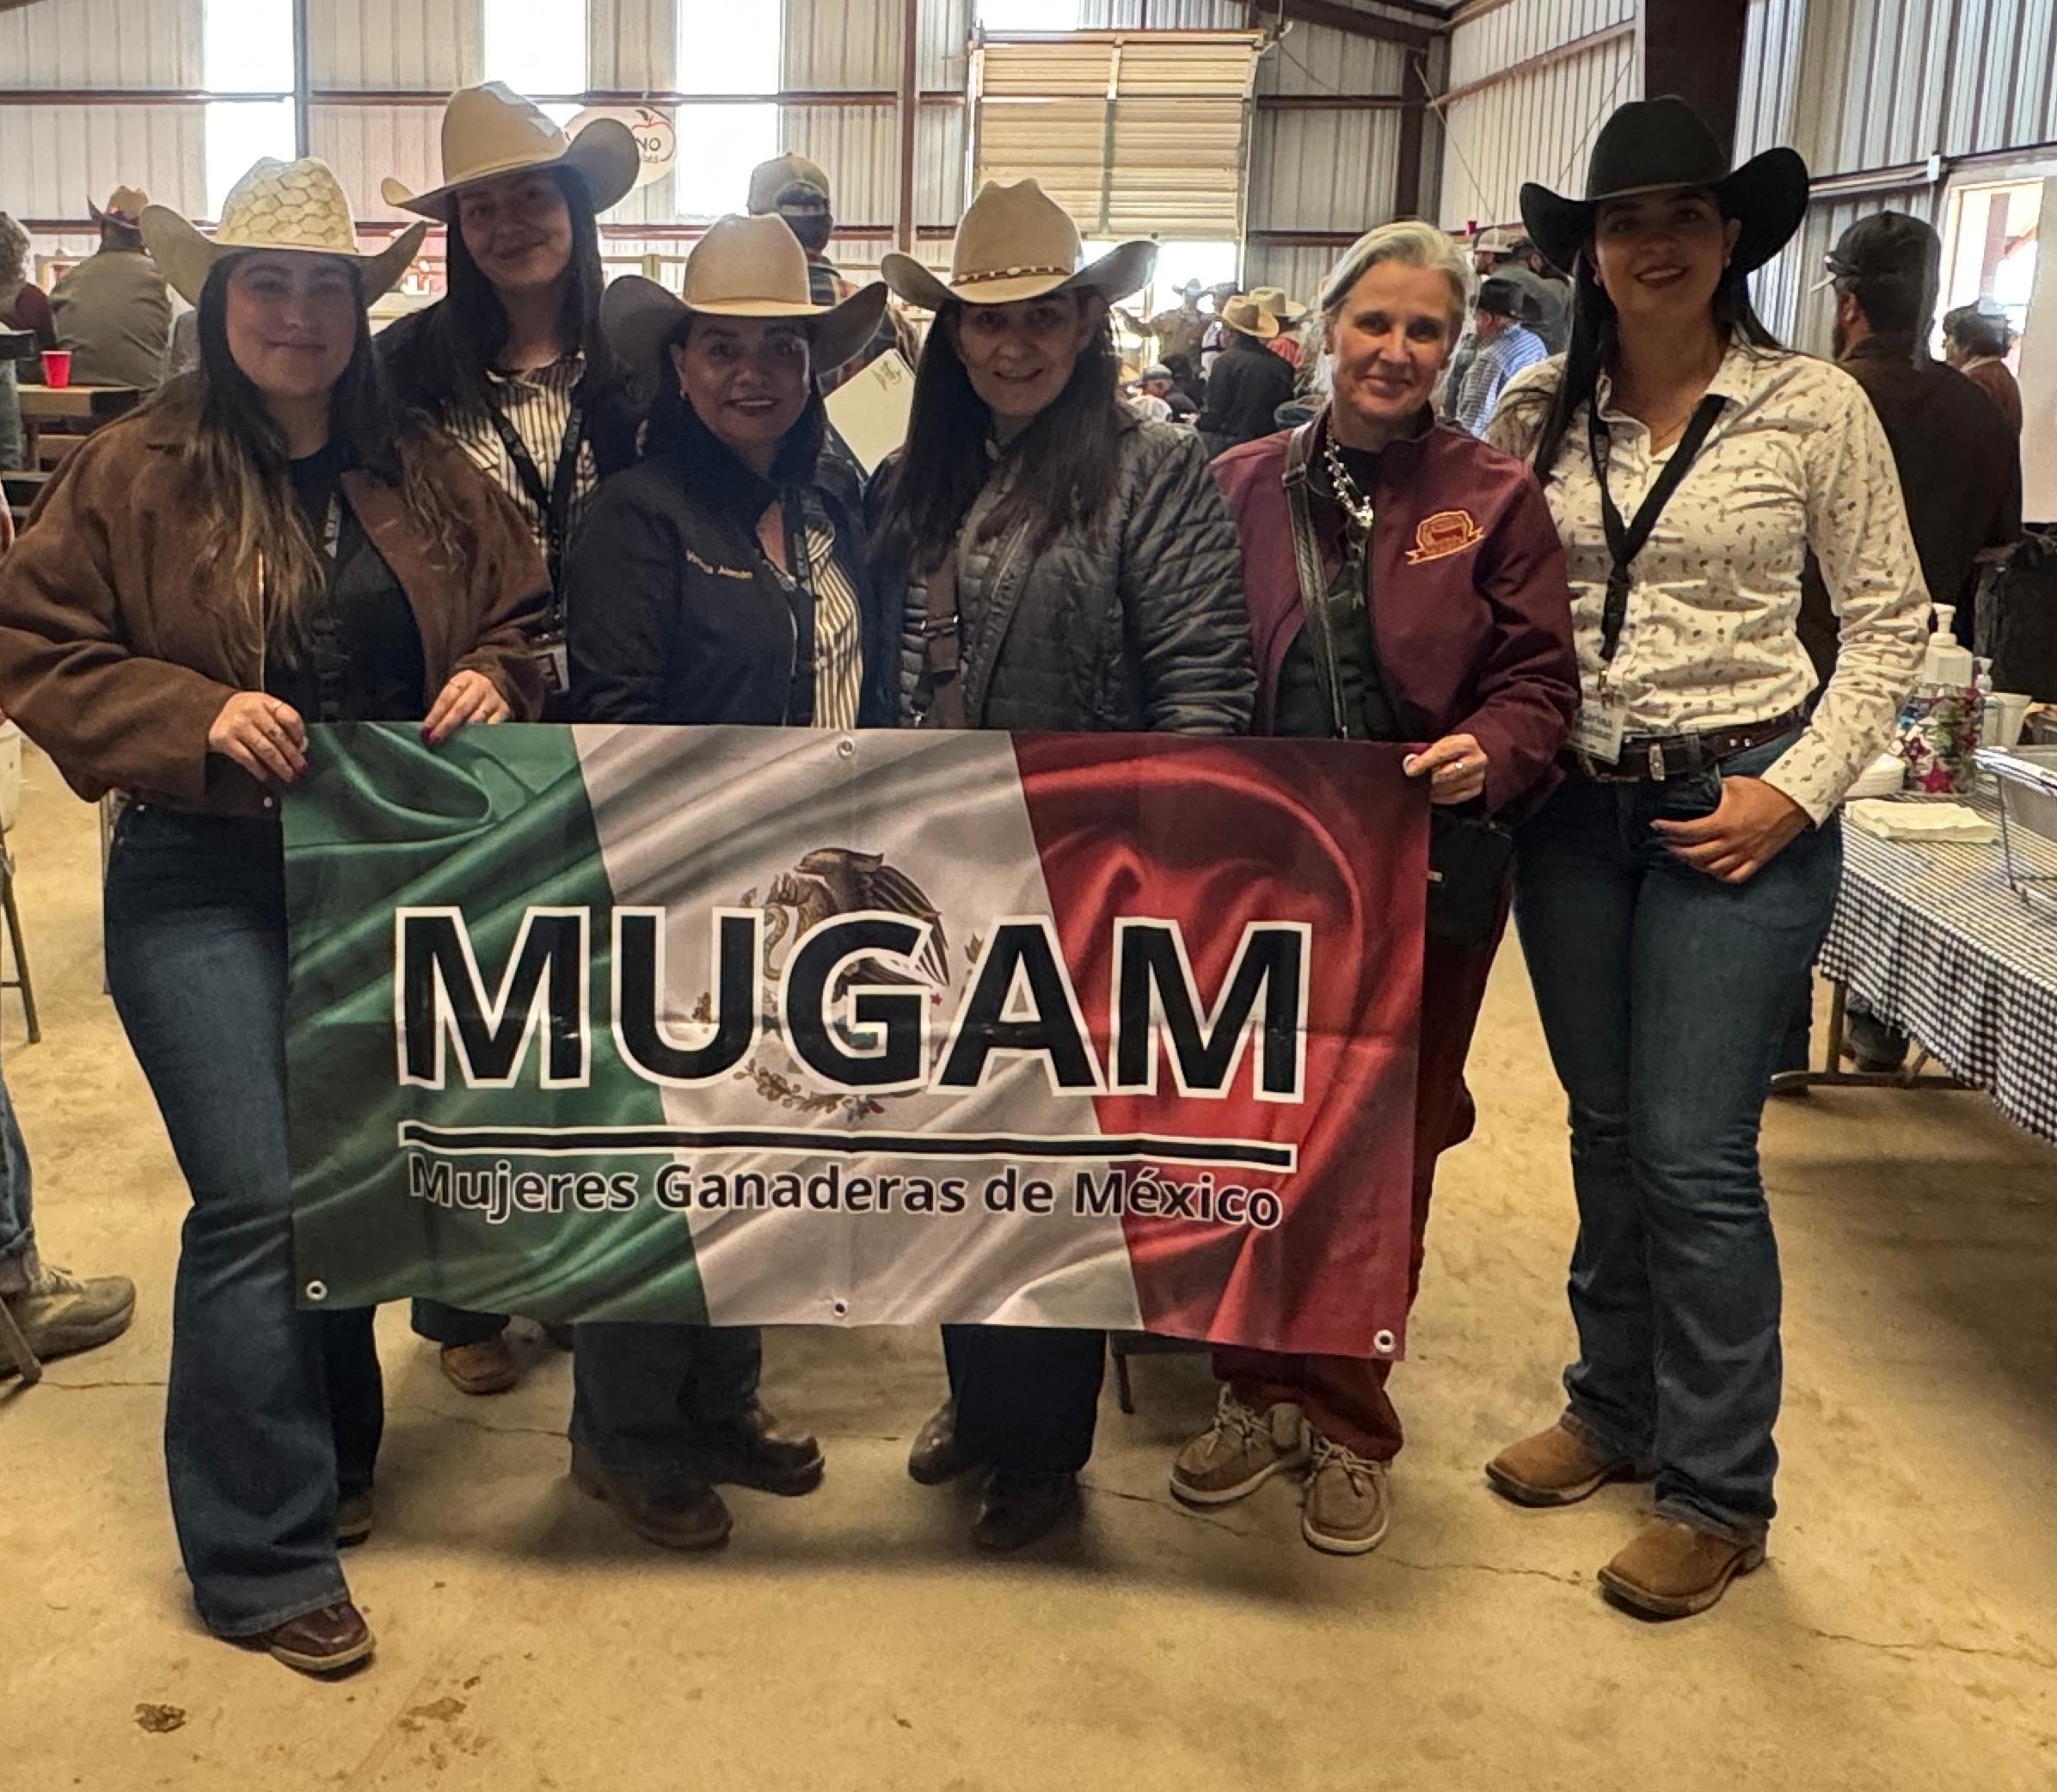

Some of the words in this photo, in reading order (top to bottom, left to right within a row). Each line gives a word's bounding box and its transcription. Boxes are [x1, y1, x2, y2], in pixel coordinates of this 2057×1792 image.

[395, 905, 1312, 1104] MUGAM
[409, 1154, 640, 1224] Mujeres
[655, 1163, 967, 1215] Ganaderas
[984, 1166, 1055, 1216] de
[1074, 1165, 1283, 1230] México
